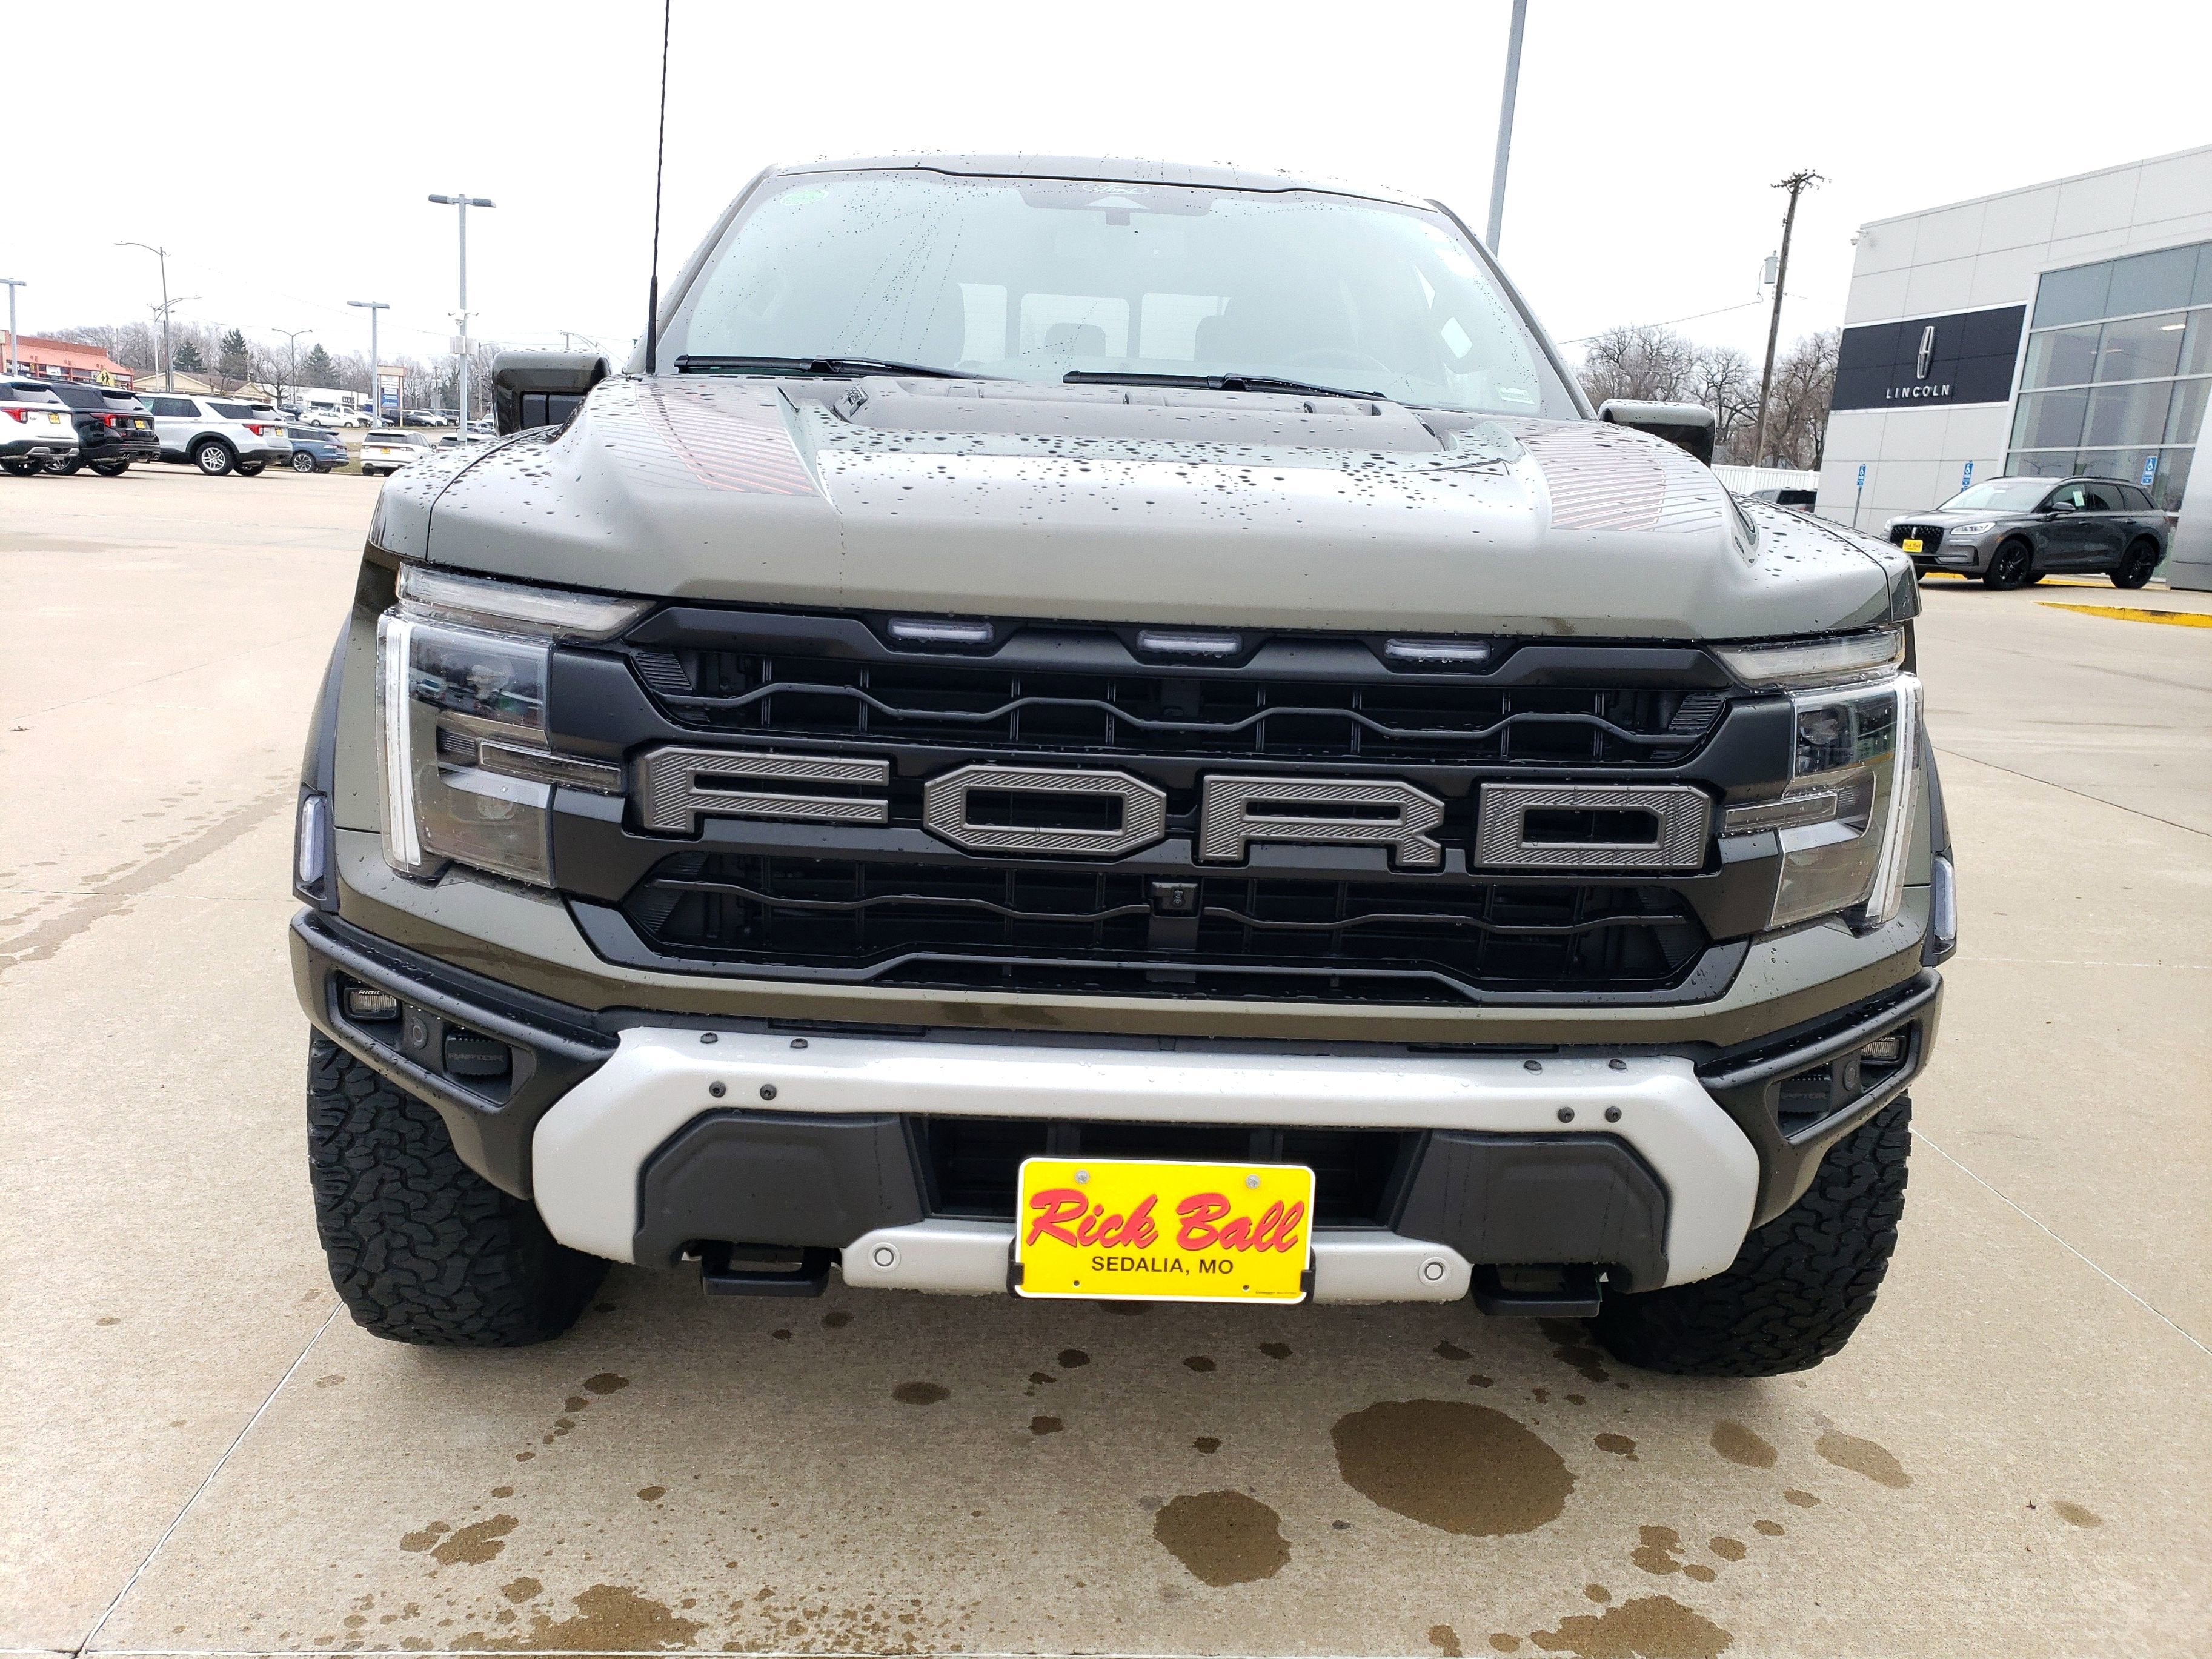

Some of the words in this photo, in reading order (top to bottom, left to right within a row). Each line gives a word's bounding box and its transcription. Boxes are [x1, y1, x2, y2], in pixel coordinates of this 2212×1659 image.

[1094, 184, 1138, 193] Ford
[1886, 384, 1950, 399] LINCOLN
[642, 746, 1712, 870] FORD
[448, 1053, 504, 1062] RAPTOR
[1026, 1188, 1159, 1248] Rick
[1175, 1192, 1304, 1253] Ball
[1091, 1256, 1190, 1277] SEDALIA,
[1198, 1259, 1234, 1274] MO
